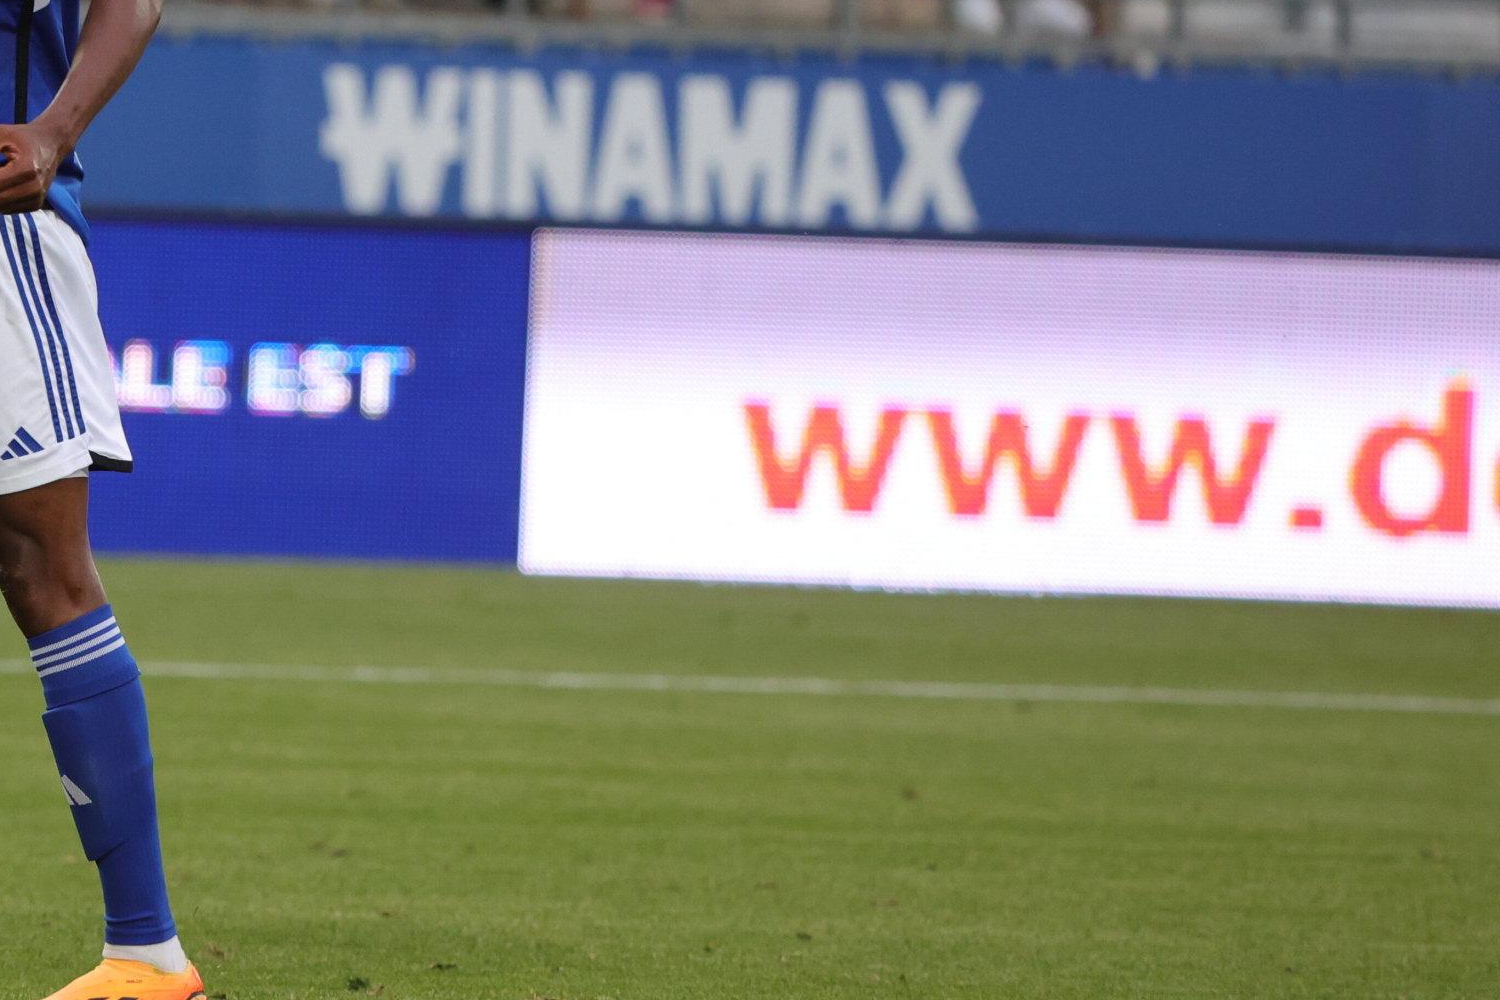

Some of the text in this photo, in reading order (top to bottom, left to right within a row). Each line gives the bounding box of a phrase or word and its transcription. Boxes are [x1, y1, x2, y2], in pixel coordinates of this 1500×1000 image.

[319, 63, 983, 233] WINAMAX
[248, 341, 415, 421] EST
[744, 374, 1500, 538] www.d
